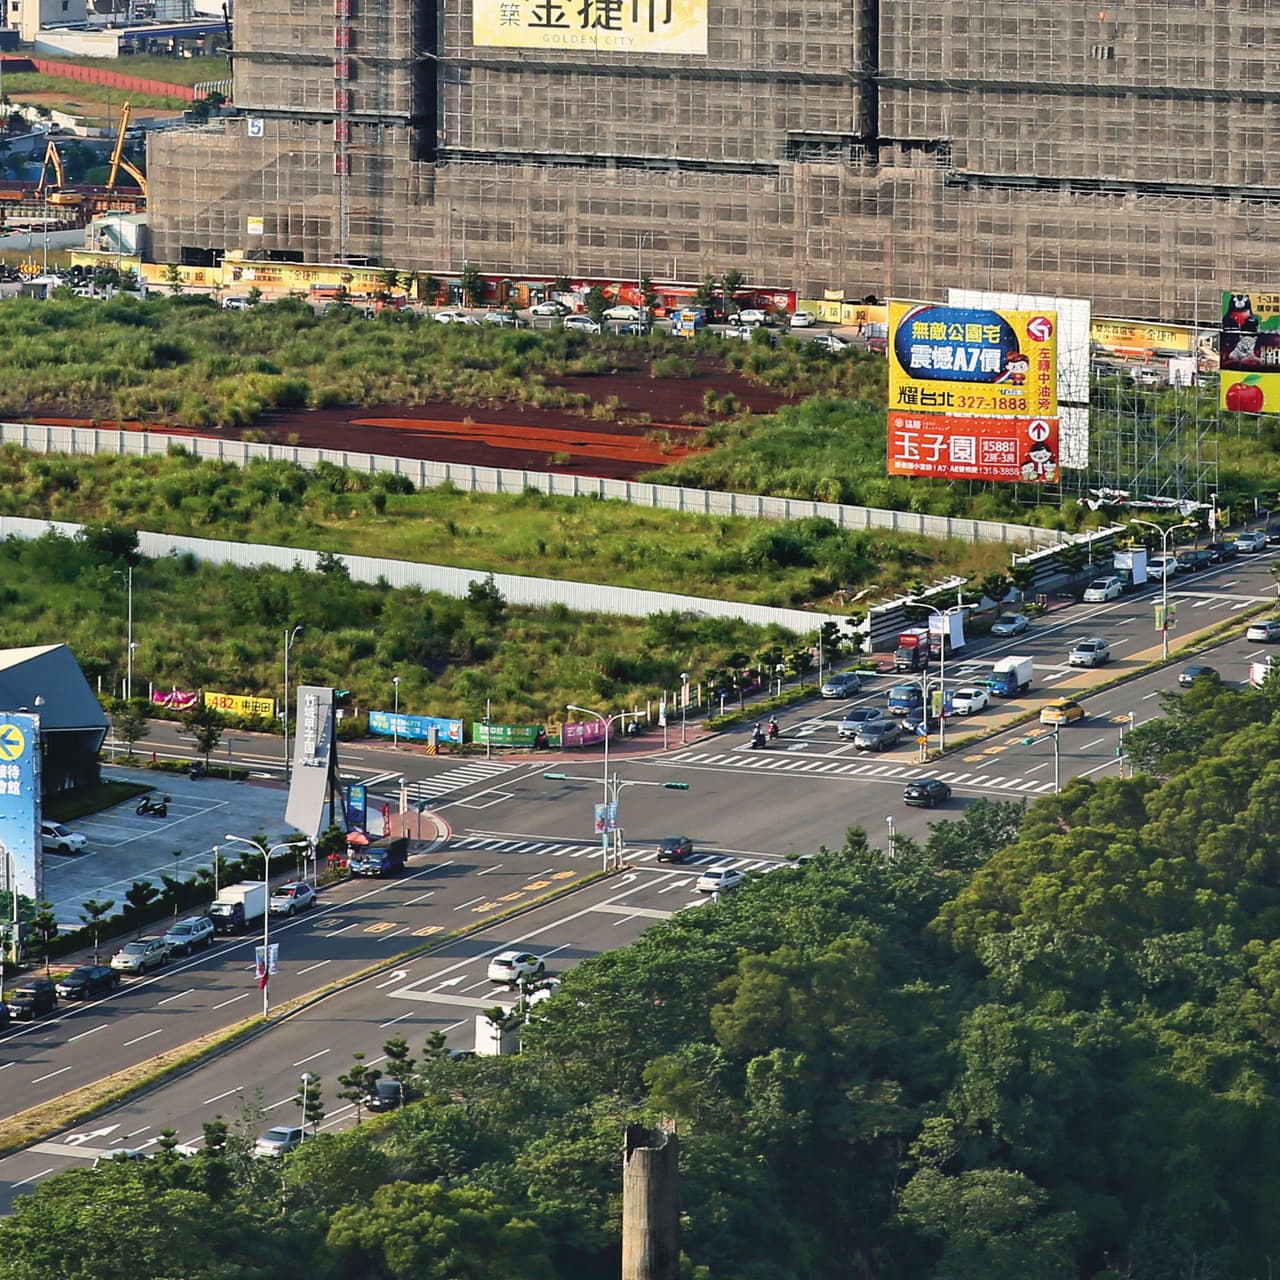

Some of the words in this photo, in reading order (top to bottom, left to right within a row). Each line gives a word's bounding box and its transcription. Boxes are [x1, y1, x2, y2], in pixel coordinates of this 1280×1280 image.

[543, 33, 597, 44] GOLDEN
[605, 36, 635, 46] CITY
[251, 120, 261, 135] 5
[911, 320, 1001, 344] 無敵公園宅
[897, 385, 955, 407] 耀台北
[957, 395, 1027, 411] 327-1888
[894, 431, 976, 464] 玉子園
[304, 693, 316, 754] 竹城甲子園
